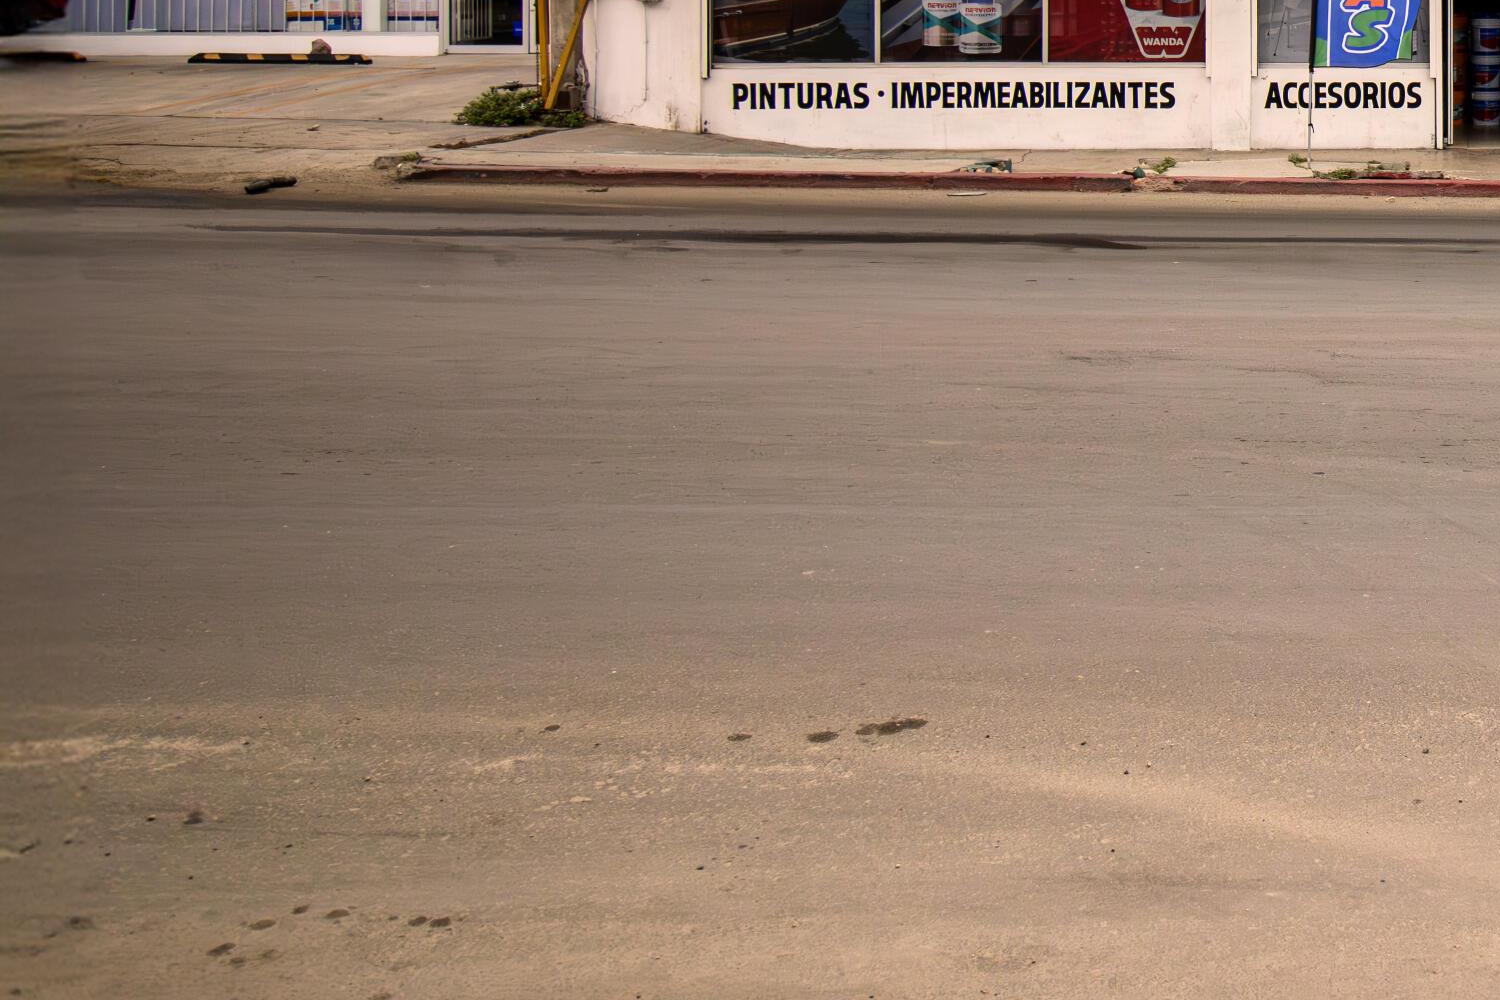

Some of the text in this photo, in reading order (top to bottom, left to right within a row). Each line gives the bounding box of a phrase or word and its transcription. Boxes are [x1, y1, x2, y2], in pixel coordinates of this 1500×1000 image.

[1142, 37, 1184, 46] WANDA
[732, 81, 1176, 110] PINTURAS IMPERMEABILIZANTES
[1264, 81, 1422, 109] ACCESORIOS
